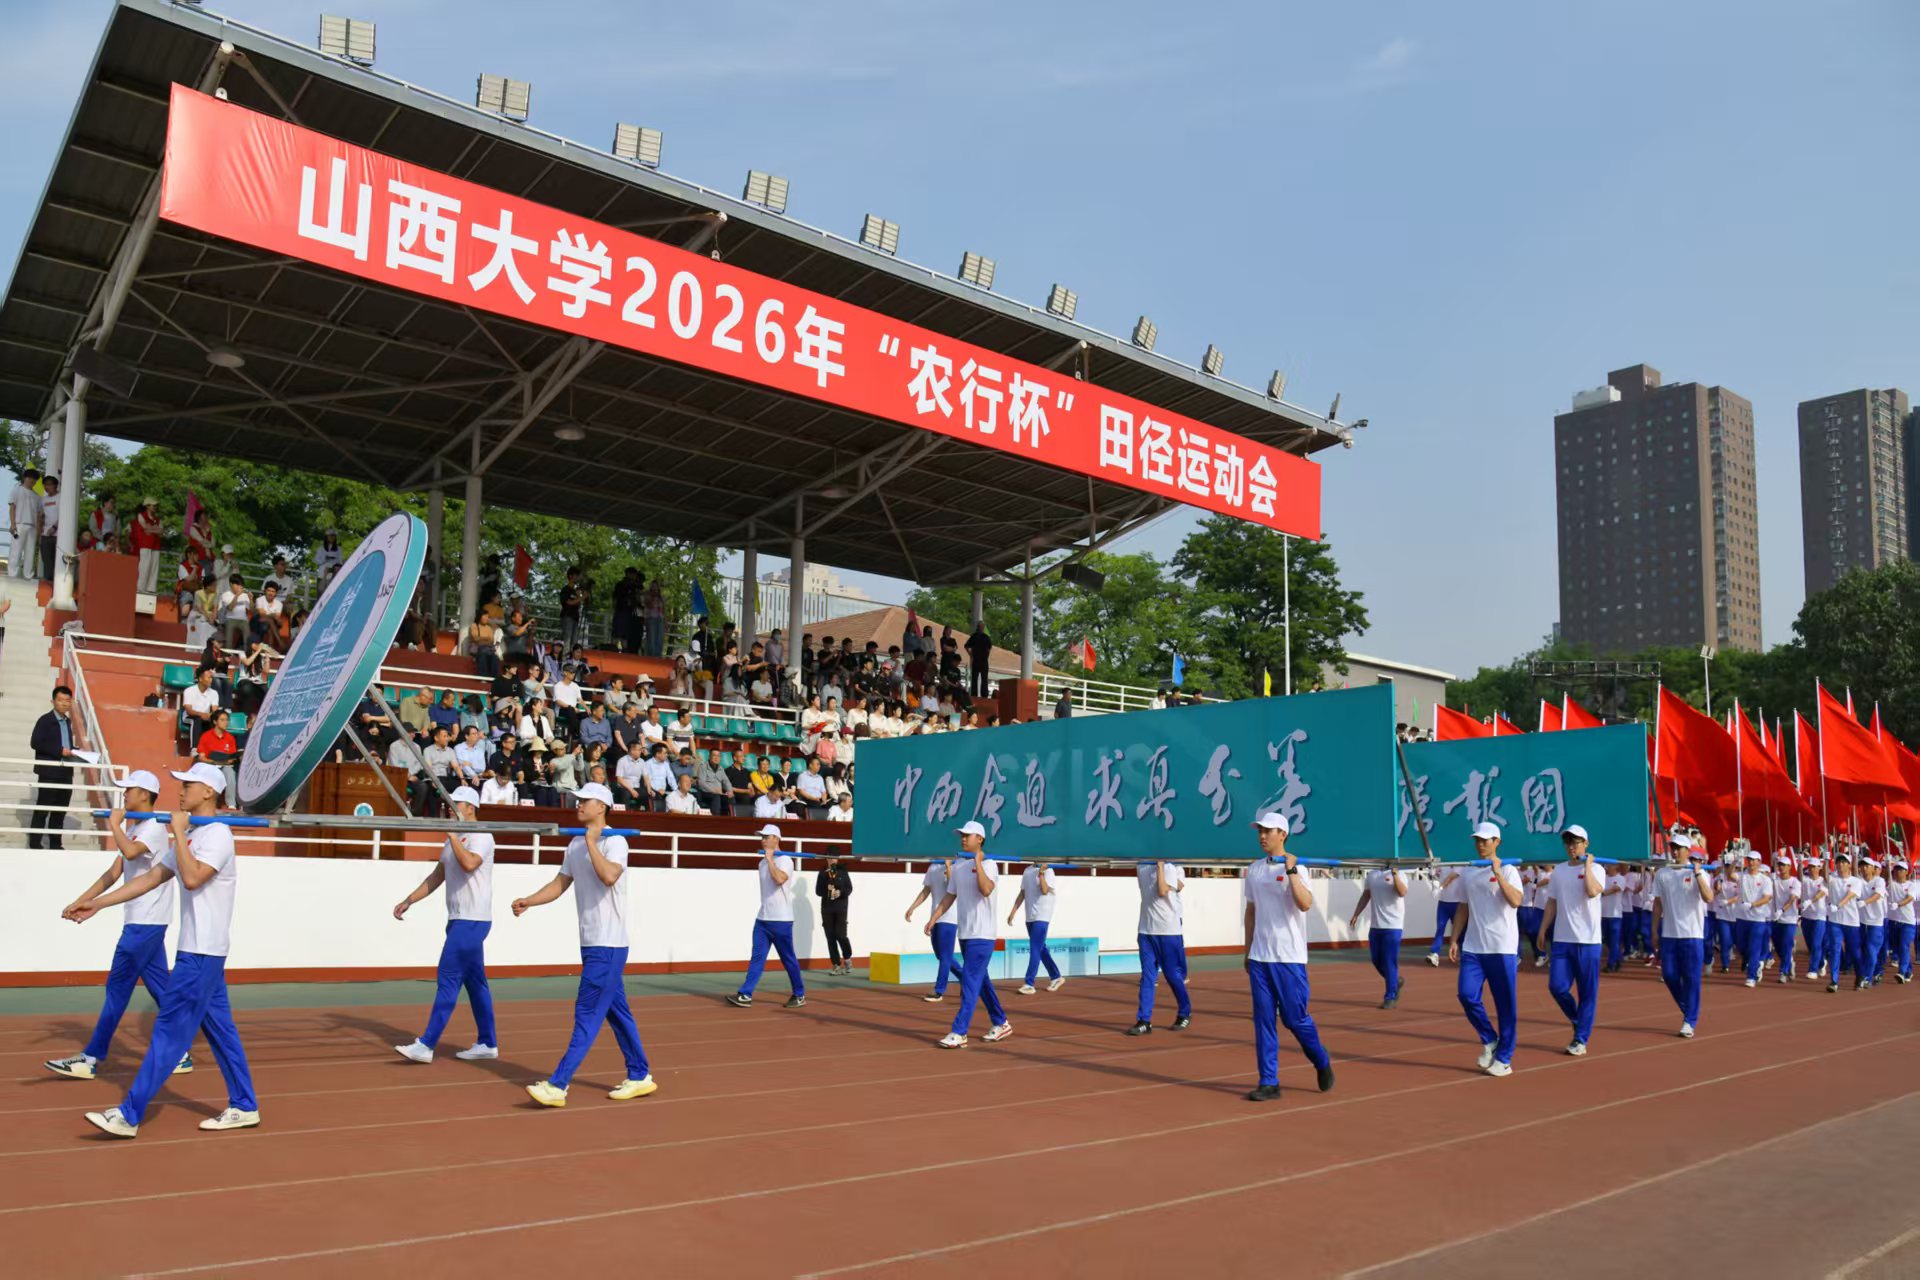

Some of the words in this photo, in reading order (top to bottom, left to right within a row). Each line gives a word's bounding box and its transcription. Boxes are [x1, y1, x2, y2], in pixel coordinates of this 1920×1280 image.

[297, 157, 846, 388] 山西大学2026年
[1098, 403, 1278, 519] 田径运动会
